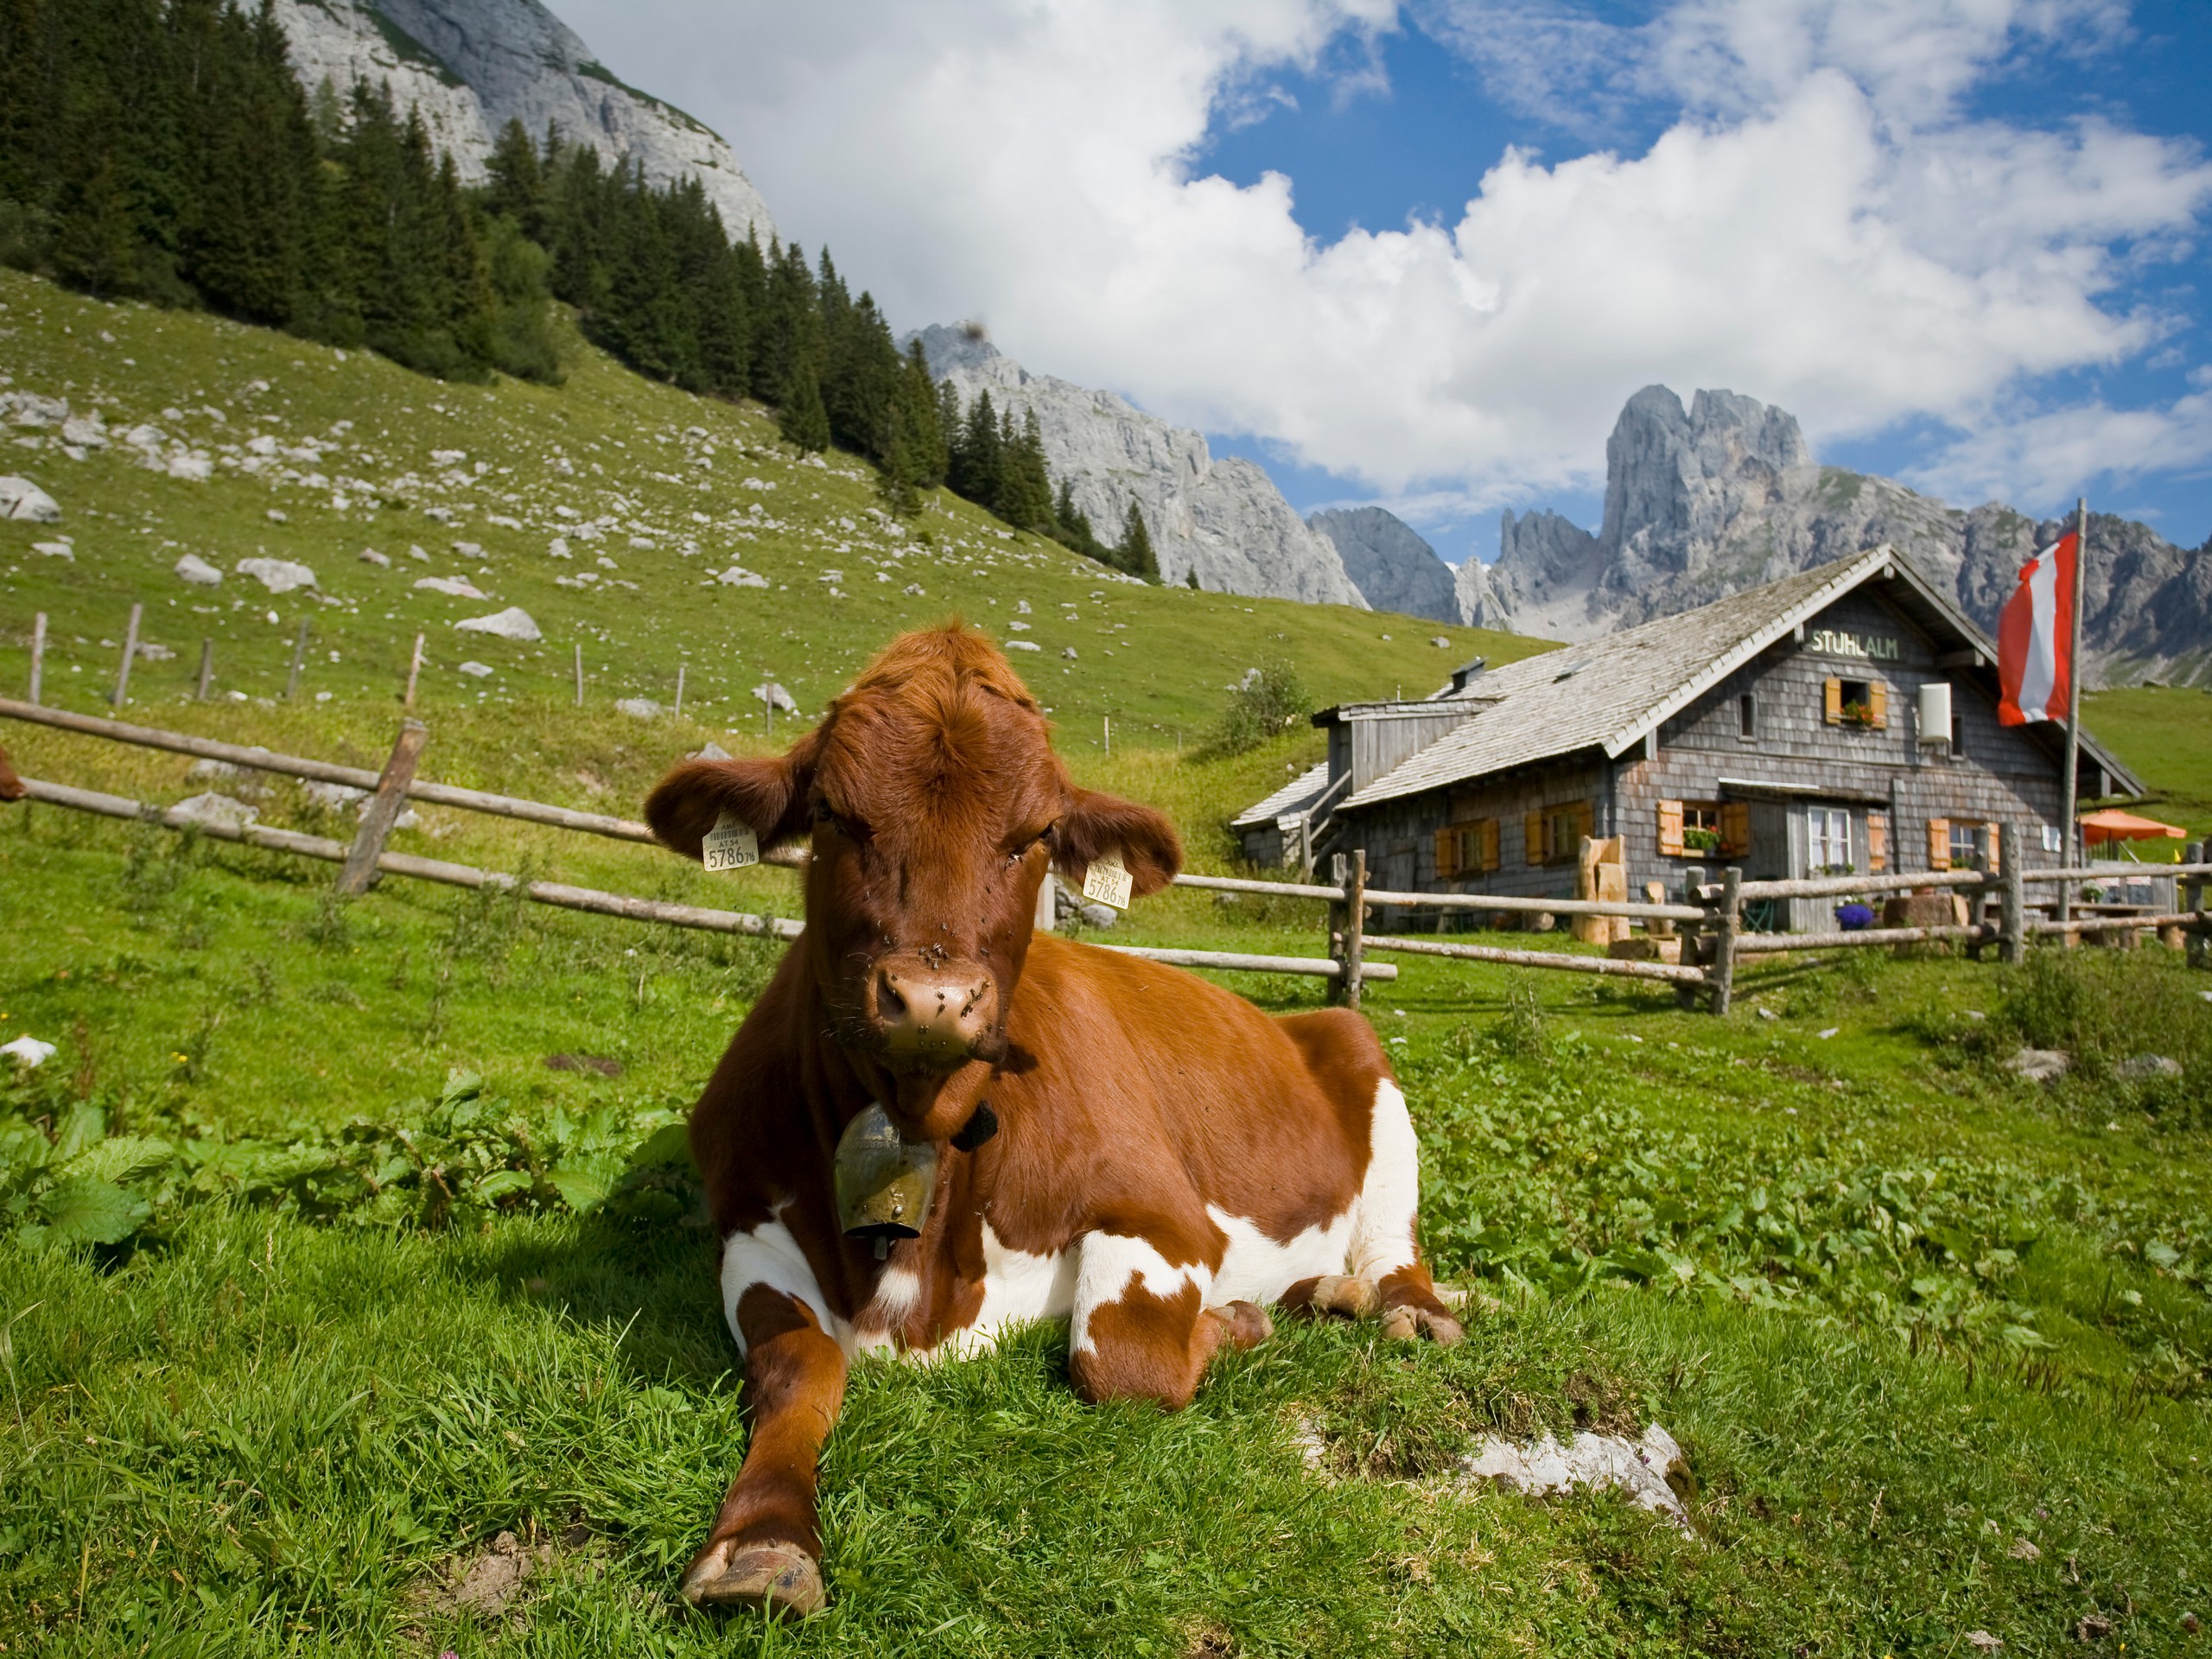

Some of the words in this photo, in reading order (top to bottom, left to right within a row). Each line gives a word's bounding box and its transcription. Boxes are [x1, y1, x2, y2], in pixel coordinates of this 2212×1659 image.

[1812, 630, 1898, 659] STUHLALM
[709, 847, 744, 868] 5786
[1089, 879, 1116, 903] 5786
